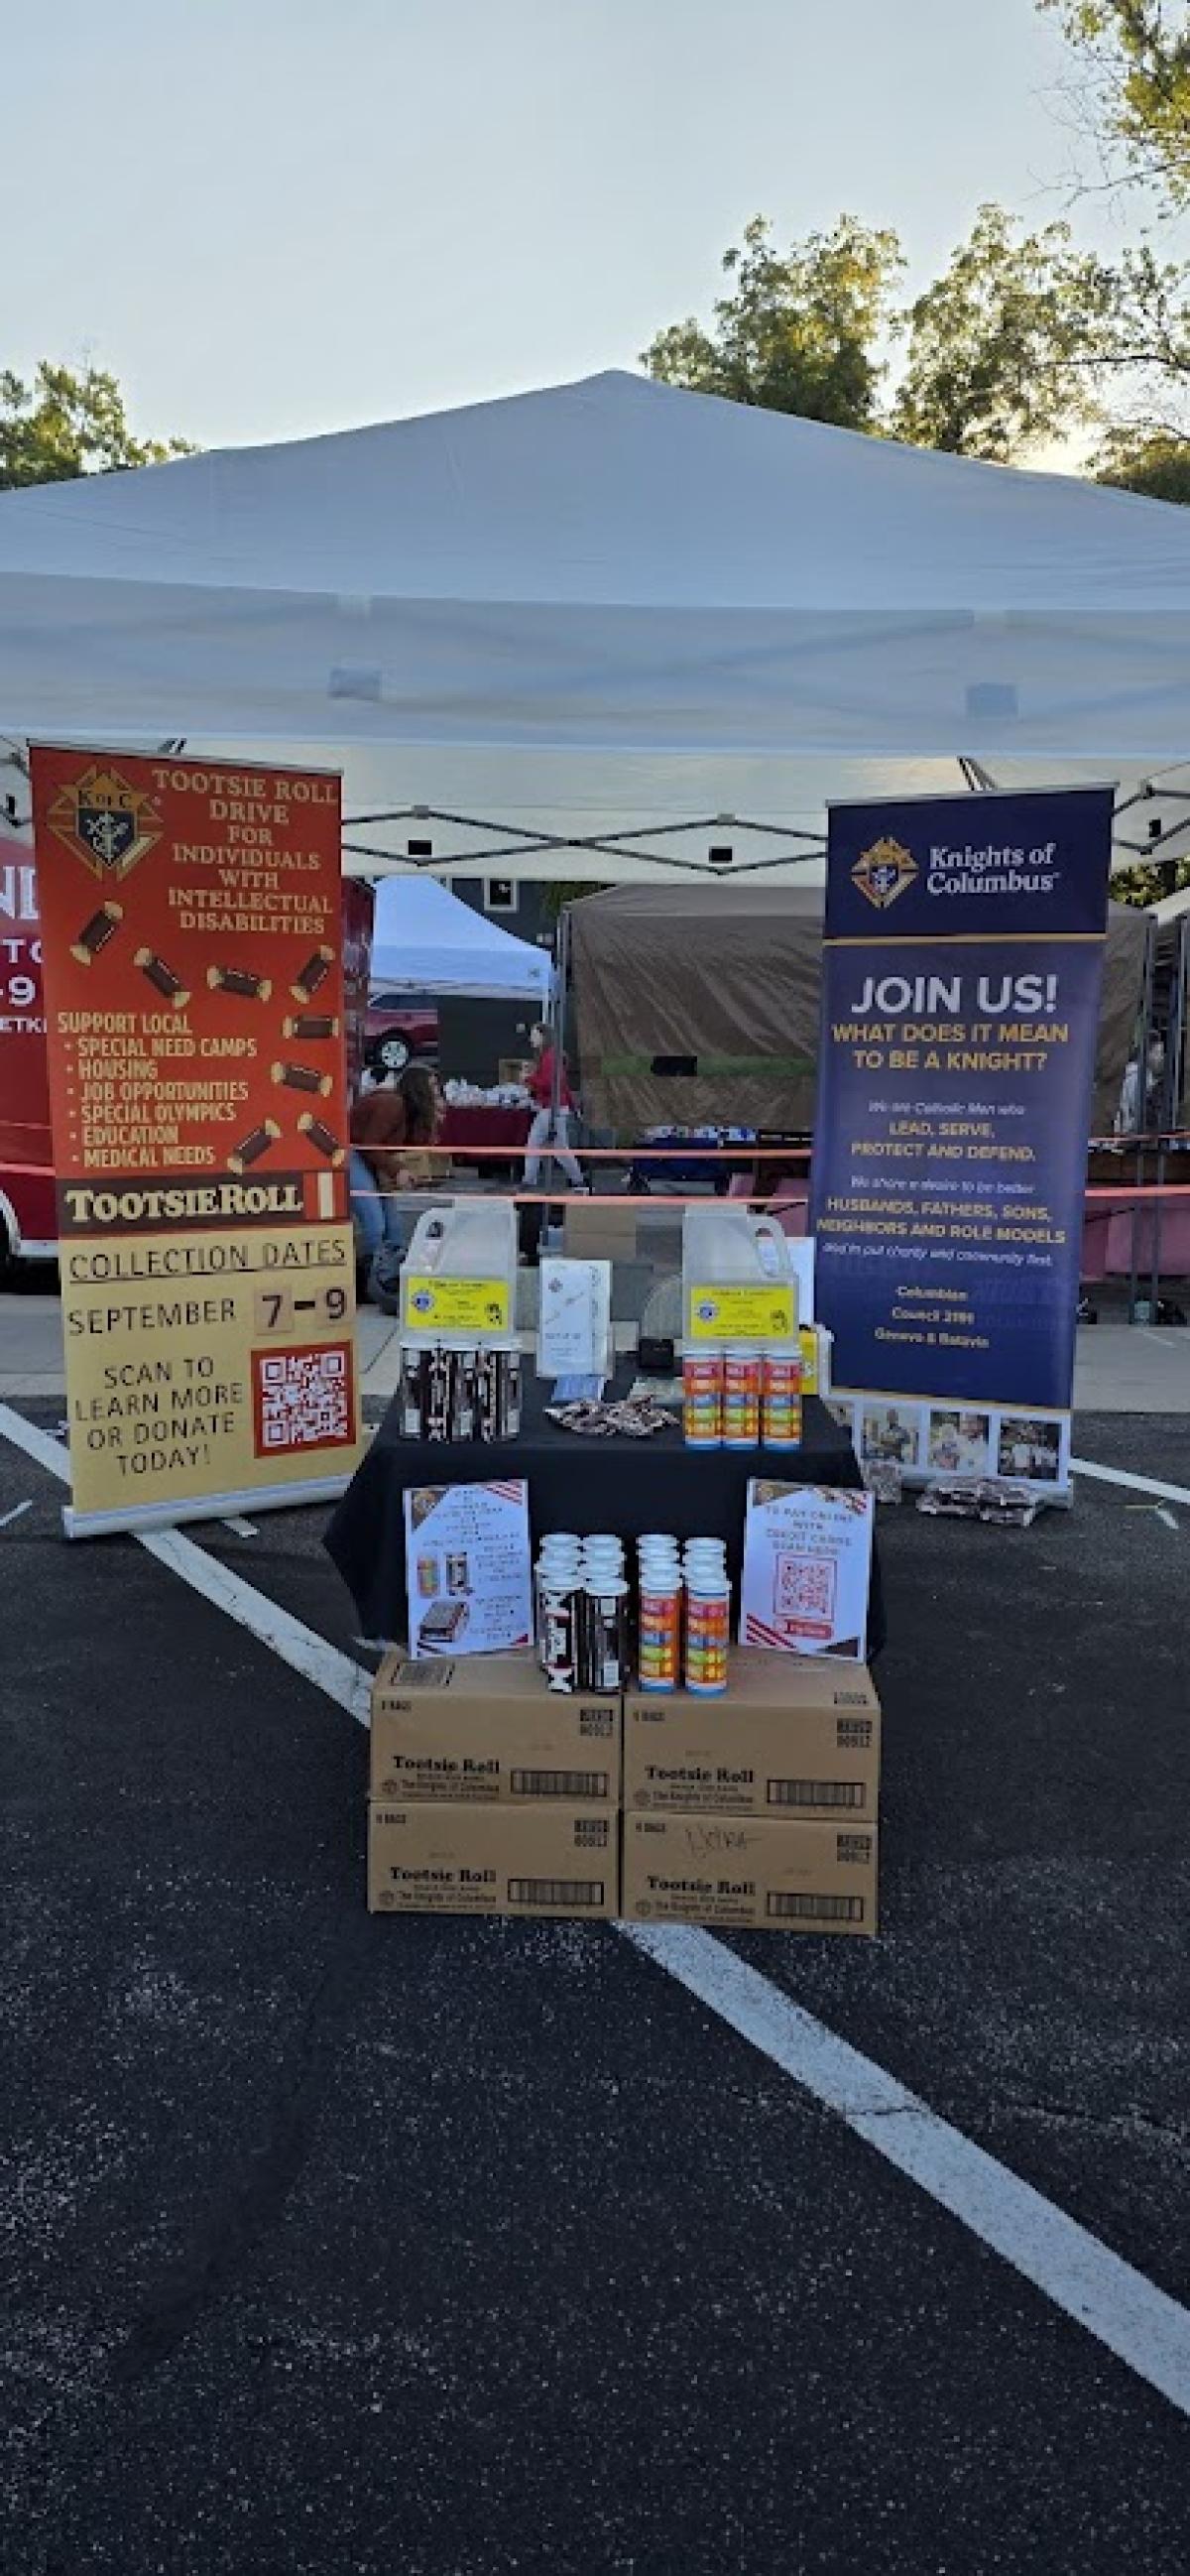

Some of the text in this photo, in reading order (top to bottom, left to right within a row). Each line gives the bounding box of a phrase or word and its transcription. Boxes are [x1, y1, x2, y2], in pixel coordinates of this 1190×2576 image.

[152, 769, 338, 803] TOOTSIE ROLL
[209, 799, 289, 824] DRIVE
[228, 826, 273, 846] FOR
[174, 843, 321, 870] INDIVIDUALS
[930, 843, 1057, 872] Knights of
[219, 869, 279, 890] WITH
[927, 870, 1054, 894] Columbus
[169, 888, 333, 915] INTELLECTUAL
[179, 912, 325, 934] DISABILITIES
[851, 975, 1058, 1013] JOIN US!
[58, 1013, 193, 1035] SUPPORT LOCAL
[832, 1023, 1069, 1043] WHAT DOES IT MEAN
[77, 1039, 258, 1057] SPECIAL NEED CAMPS
[78, 1060, 158, 1080] HOUSING
[853, 1049, 1047, 1071] TO BE A KNIGHT?
[81, 1081, 248, 1102] JOB OPPORTUNITIES
[81, 1102, 236, 1123] SPECIAL OLYMPICS
[83, 1126, 178, 1145] EDUCATION
[889, 1121, 996, 1139] LEAD, SERVE,
[84, 1146, 215, 1167] MEDICAL NEEDS
[852, 1142, 923, 1157] PROTECT
[927, 1144, 963, 1159] AND
[827, 1196, 1052, 1222] HUSBANDS, FATHERS, SONS,
[816, 1218, 1066, 1244] NEIGHBORS AND ROLE MODELS
[68, 1239, 346, 1281] COLLECTION DATES
[68, 1297, 237, 1336] SEPTEMBER
[104, 1356, 214, 1390] SCAN TO
[75, 1383, 244, 1422] LEARN MORE
[87, 1412, 236, 1451] OR DONATE
[116, 1443, 211, 1477] TODAY!
[393, 1755, 500, 1774] Tootsie Roll
[646, 1765, 754, 1783] Tootsie Roll
[390, 1867, 497, 1883] Tootsie Roll
[647, 1875, 756, 1897] Tootsie Roll
